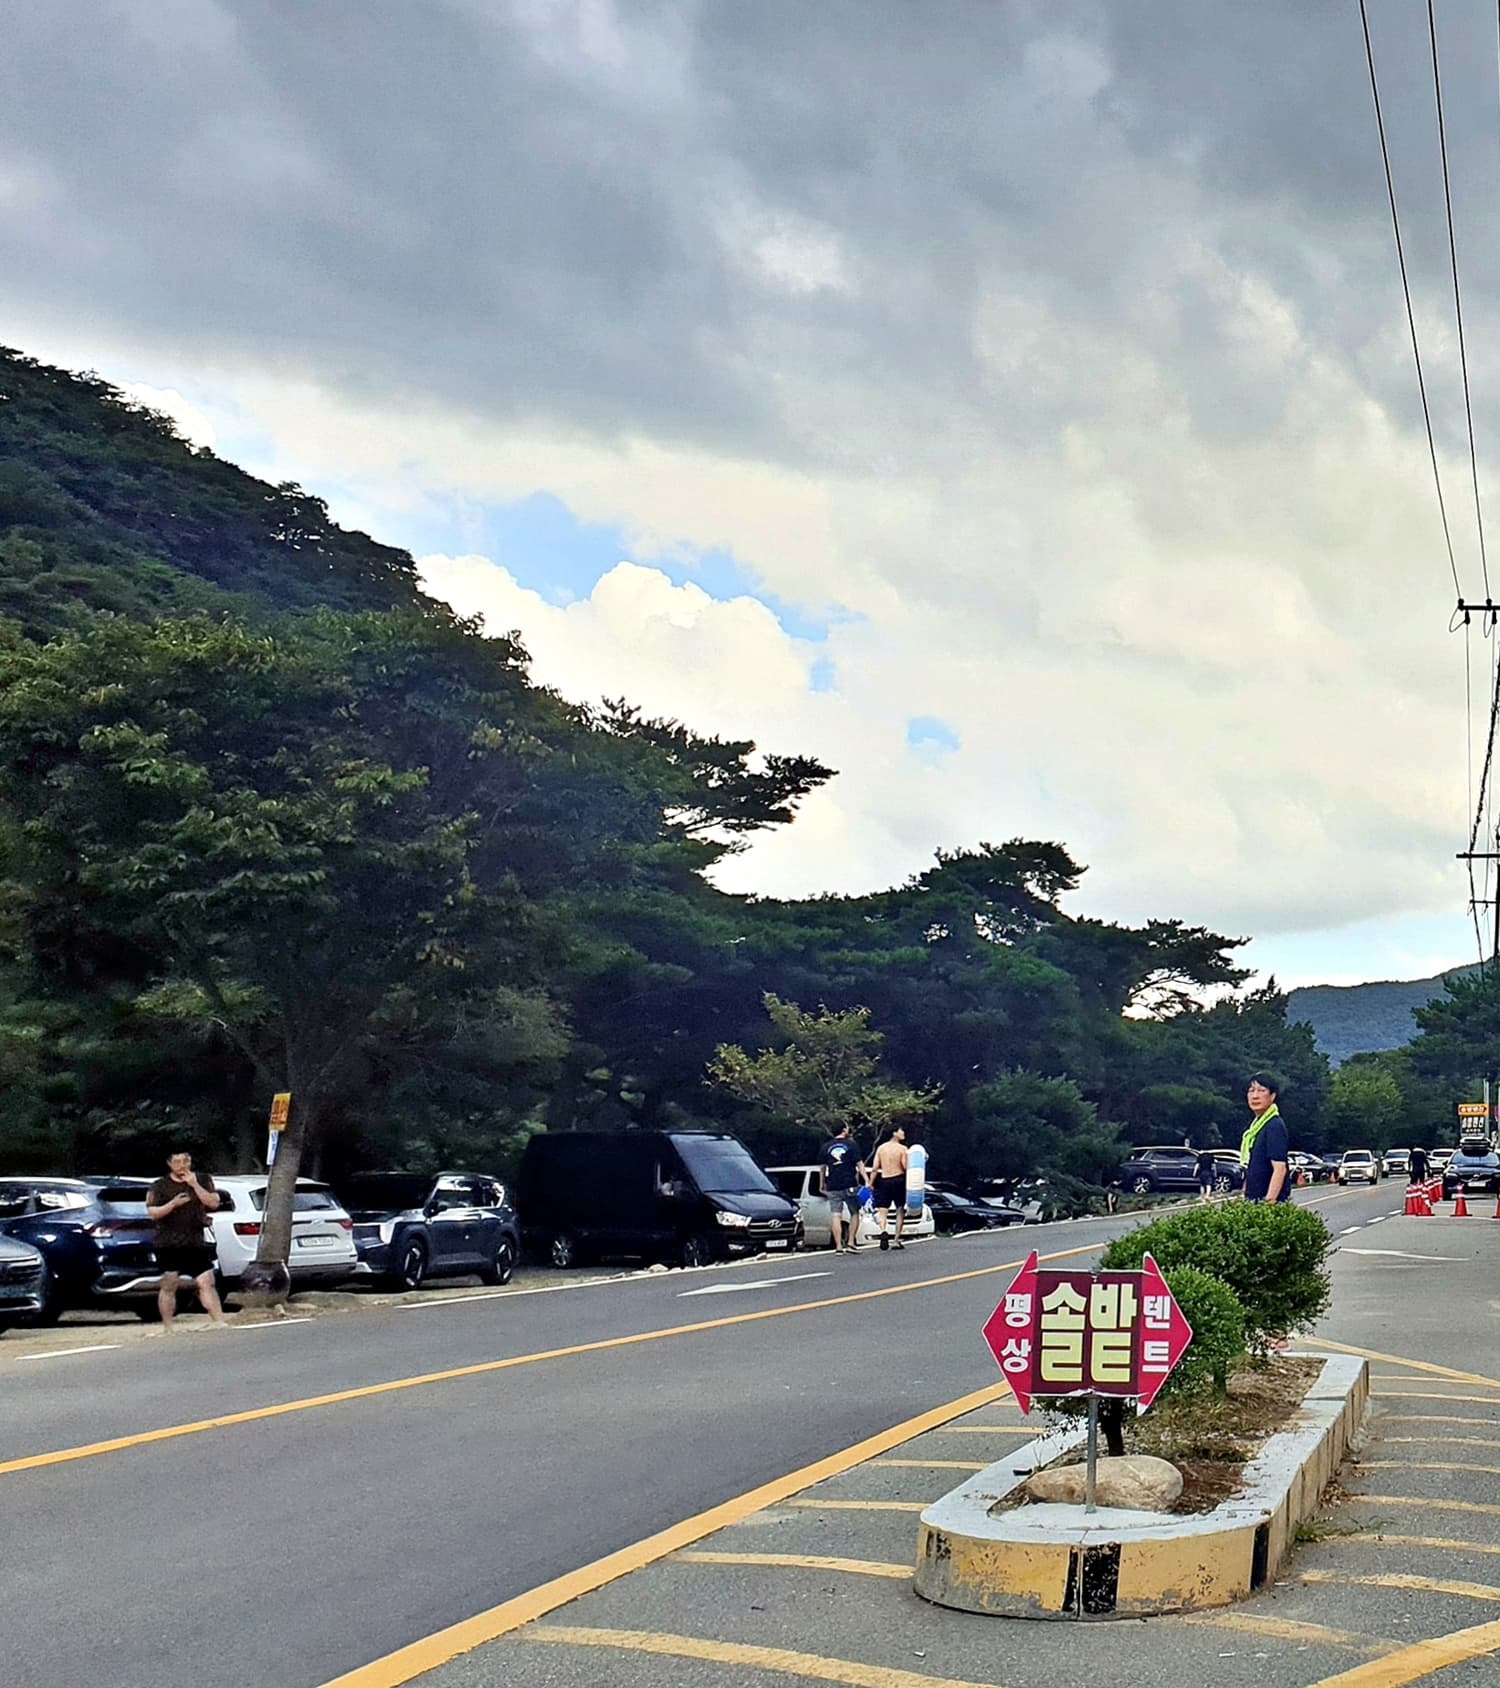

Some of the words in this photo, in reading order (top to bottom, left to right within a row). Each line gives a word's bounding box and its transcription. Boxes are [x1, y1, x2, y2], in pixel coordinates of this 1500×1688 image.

[1000, 1293, 1032, 1373] 평상
[1040, 1282, 1137, 1383] 솔밭
[1142, 1295, 1171, 1373] 텐트
